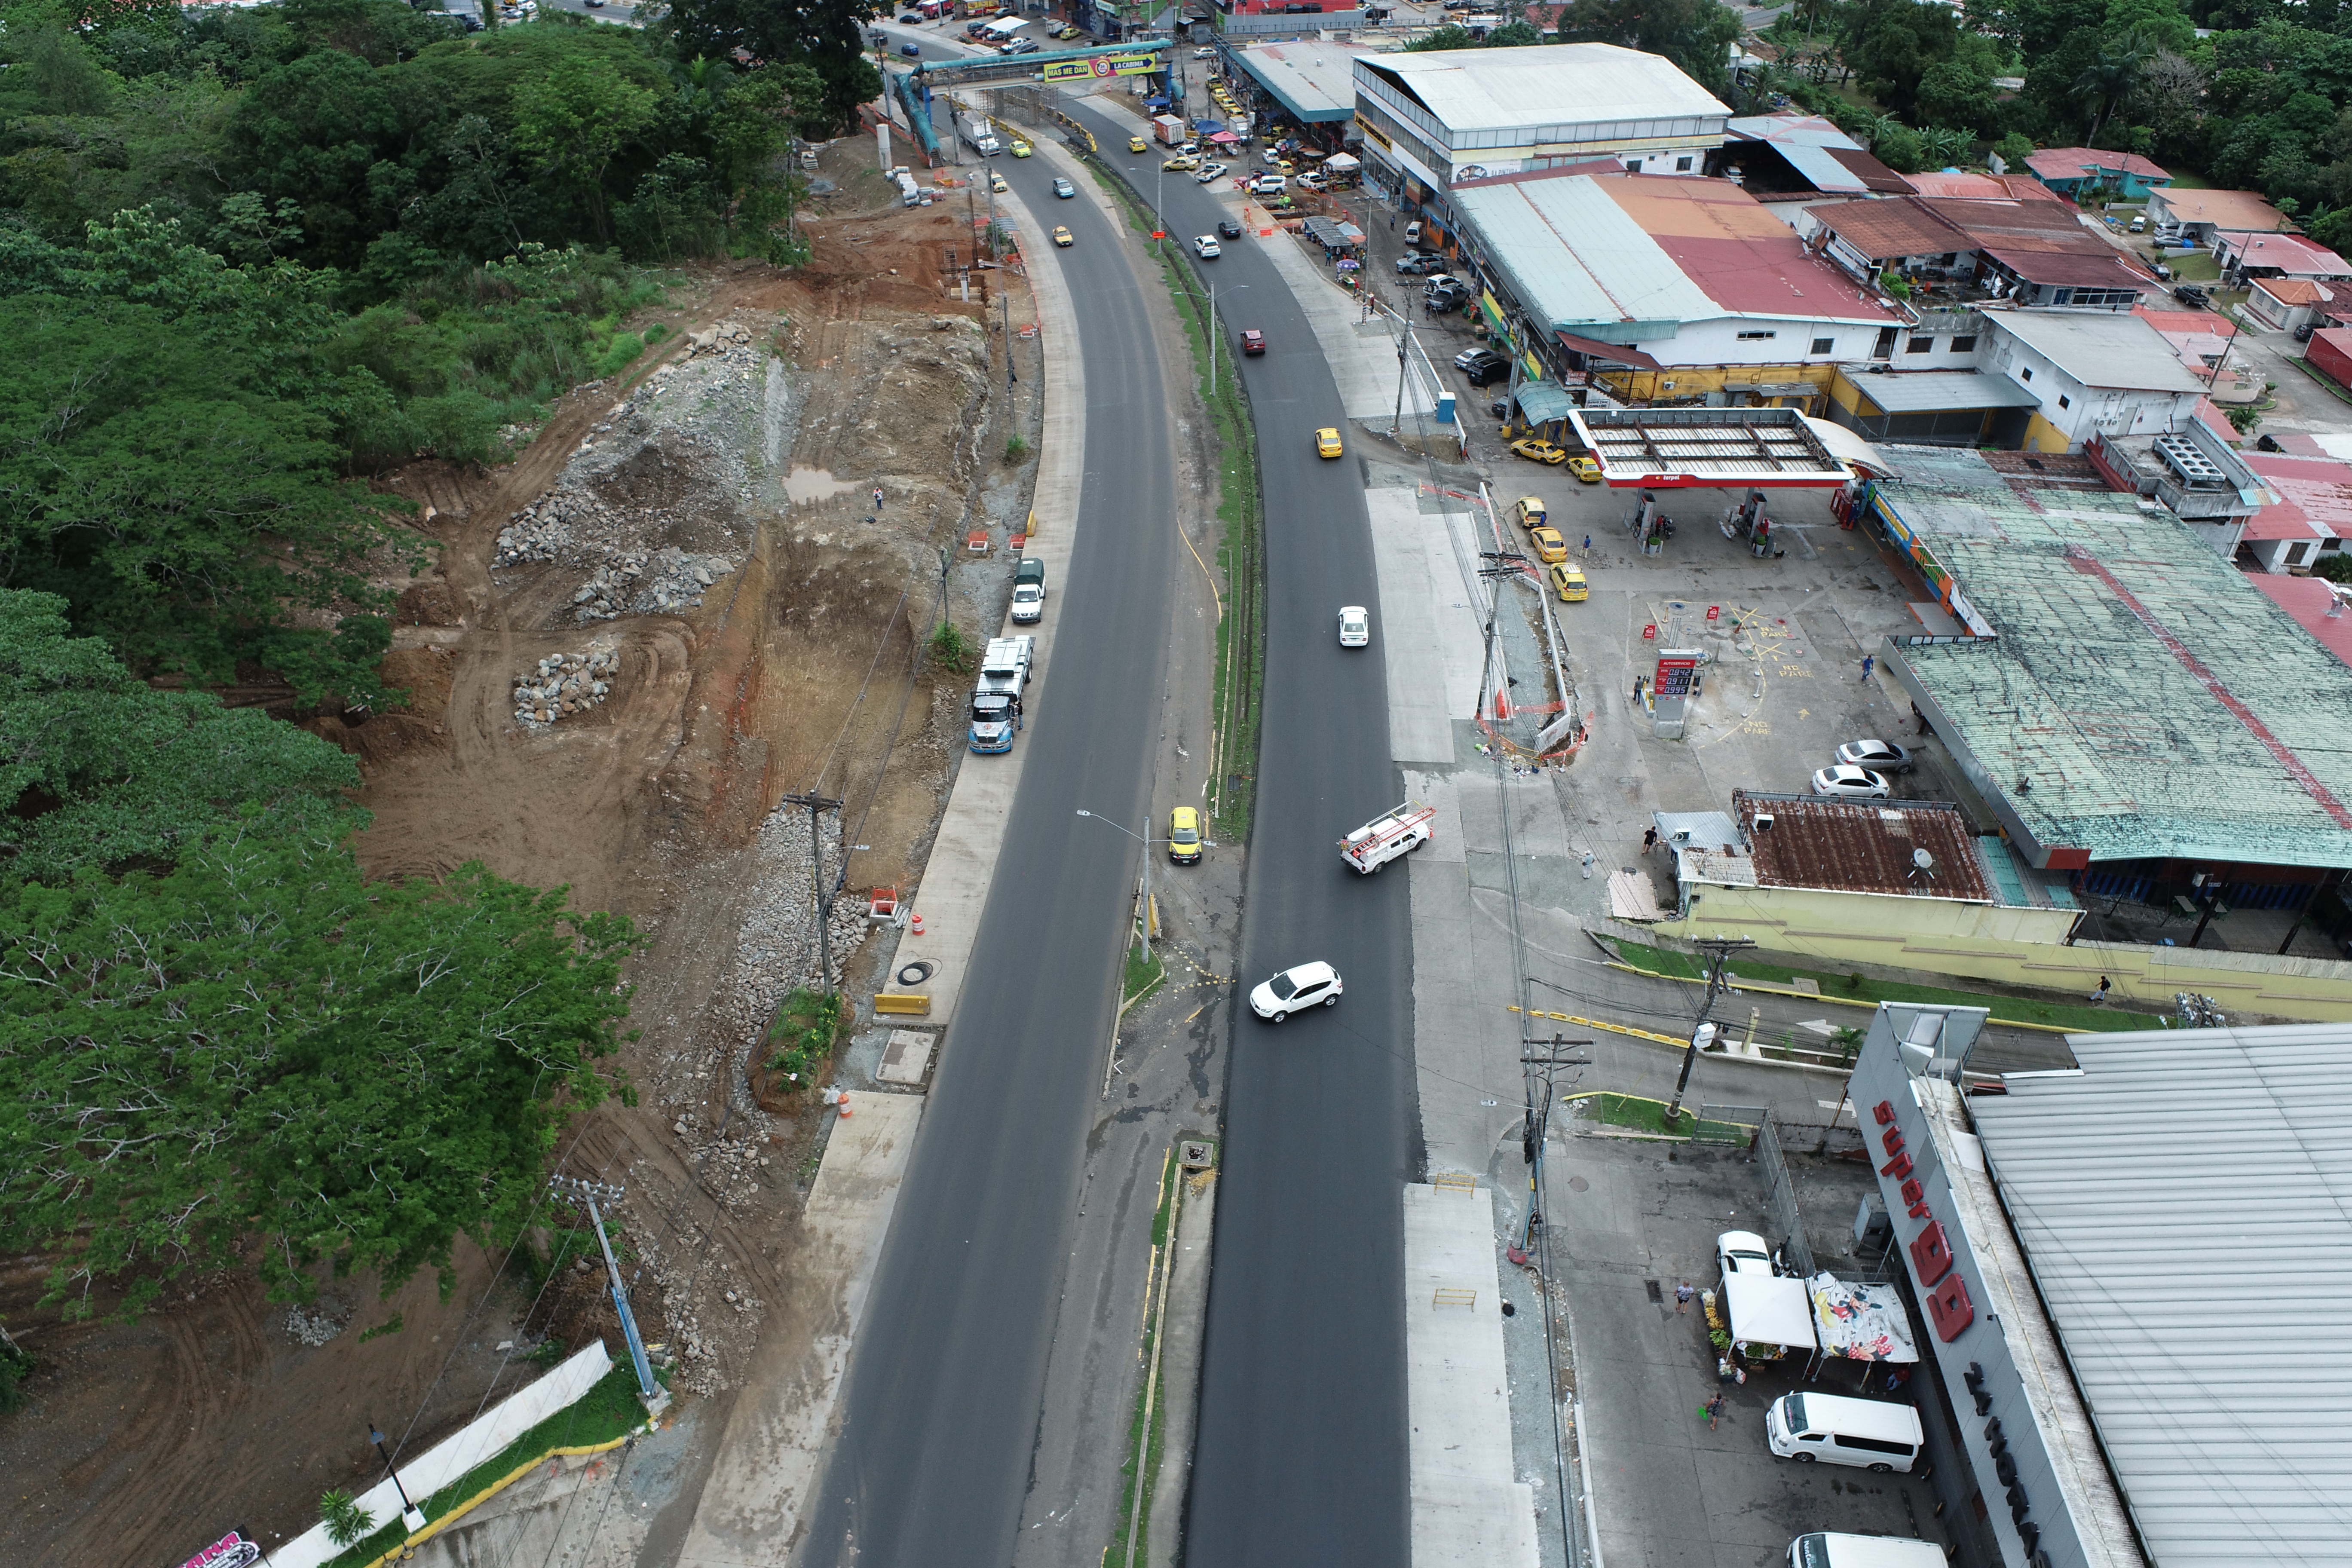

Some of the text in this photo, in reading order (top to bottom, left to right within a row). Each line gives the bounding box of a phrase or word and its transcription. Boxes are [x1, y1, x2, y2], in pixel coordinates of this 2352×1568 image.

[1048, 68, 1062, 77] MAS
[1963, 1361, 1993, 1417] 24
[177, 1533, 240, 1568] ANA
